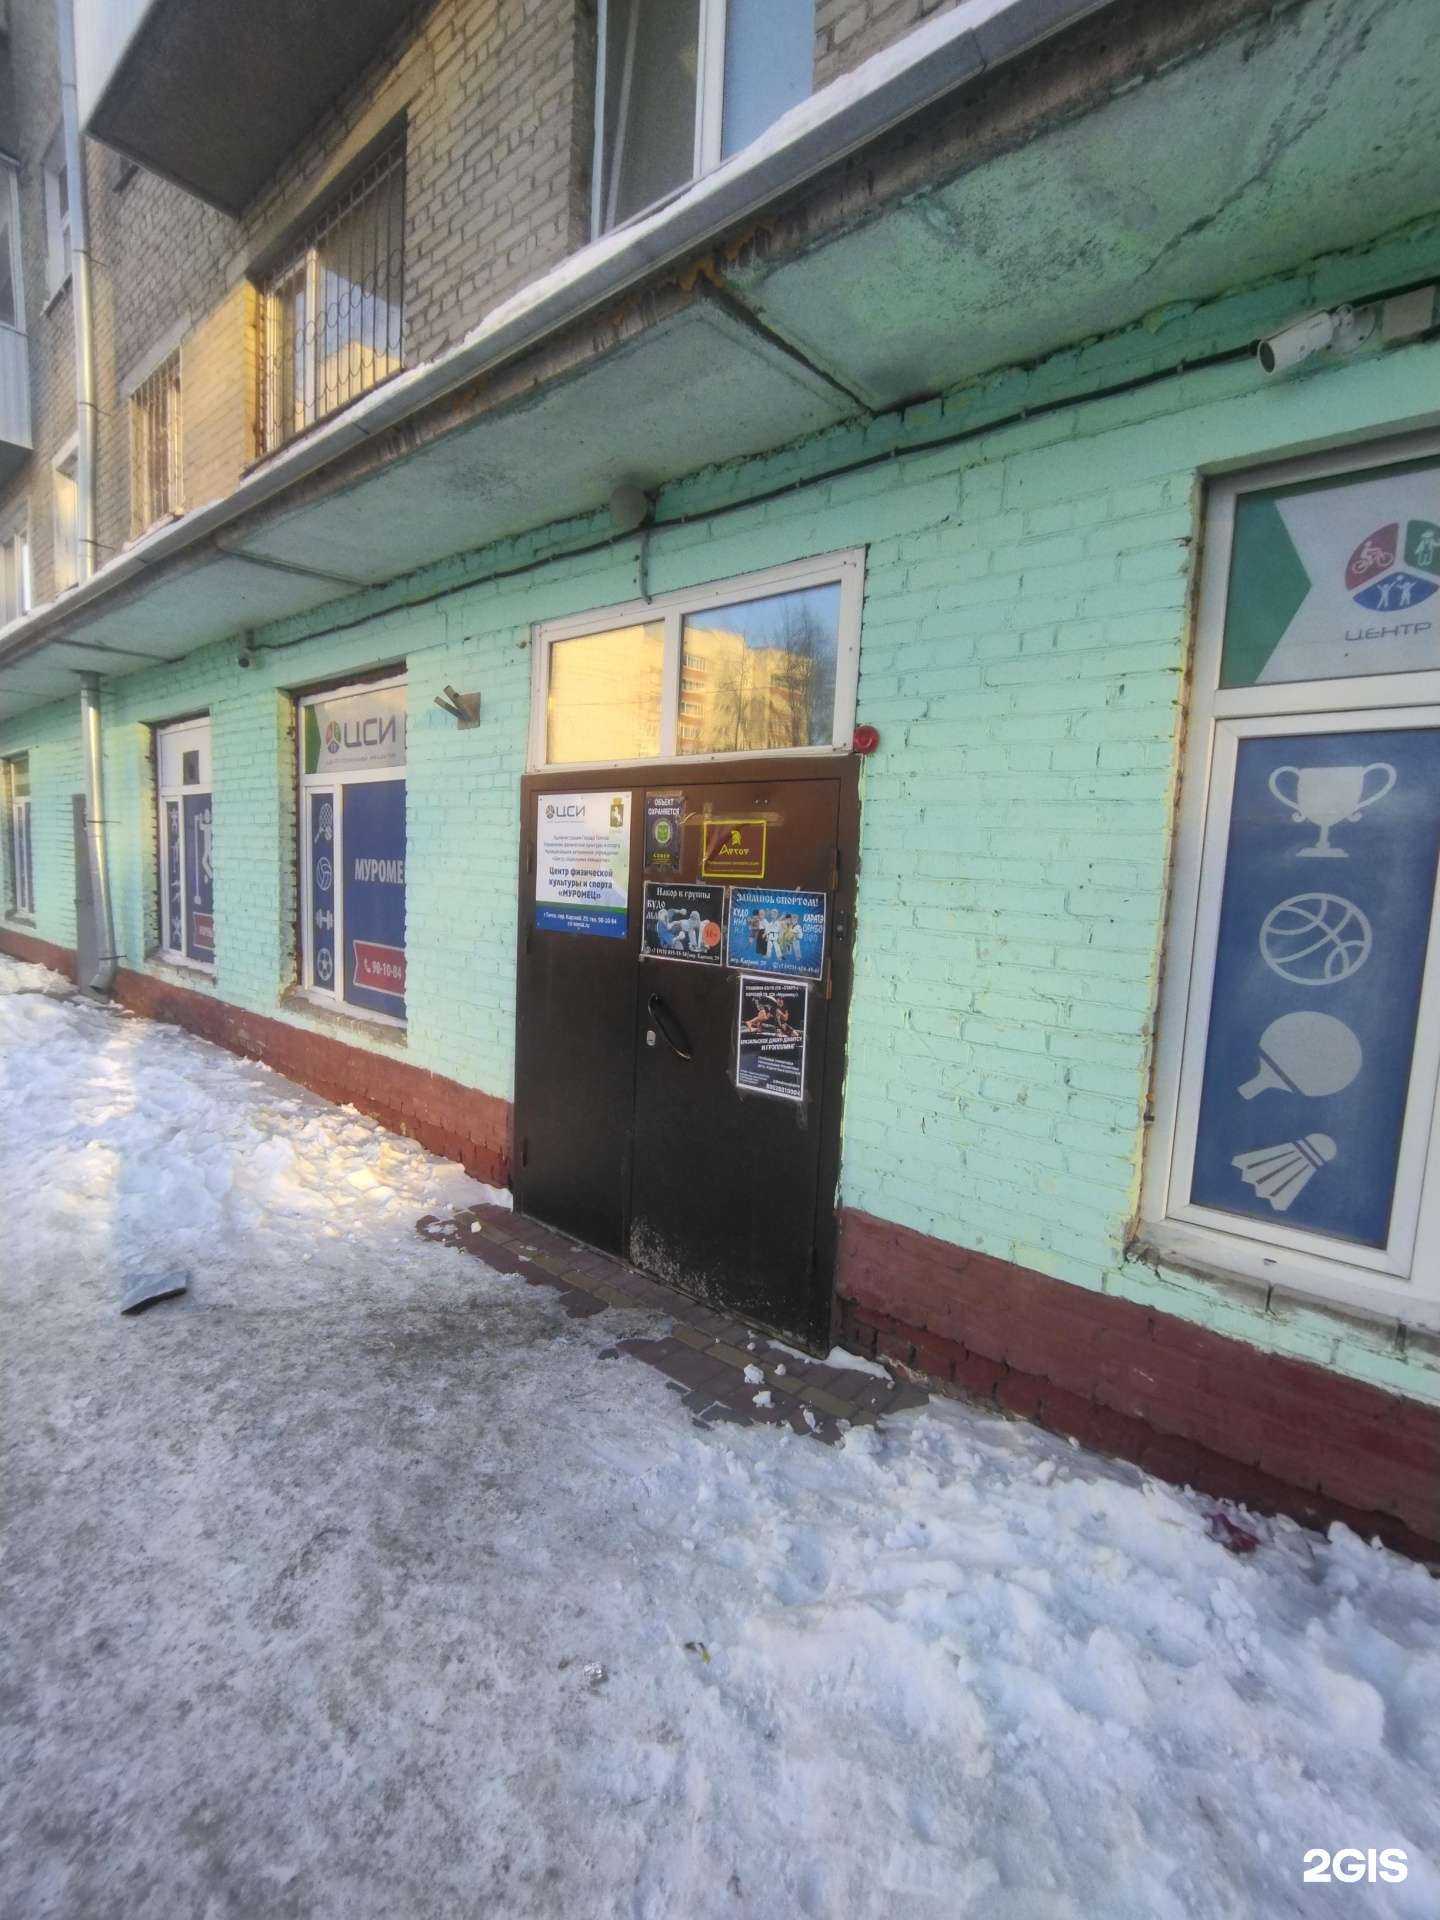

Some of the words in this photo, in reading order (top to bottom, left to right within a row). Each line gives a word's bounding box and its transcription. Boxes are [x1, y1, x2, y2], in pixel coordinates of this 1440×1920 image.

[1345, 621, 1432, 642] ЦЕНТР
[344, 715, 396, 748] ЦСИ
[654, 798, 674, 806] ОБЪЕКТ
[556, 804, 586, 818] ЦСИ
[648, 807, 680, 816] ОХРАНЯЕТСЯ
[549, 866, 569, 878] Центр
[570, 866, 614, 878] физической
[548, 878, 582, 888] культуры
[589, 880, 613, 889] спорта
[558, 889, 602, 900] «МУРОМЕЦ»
